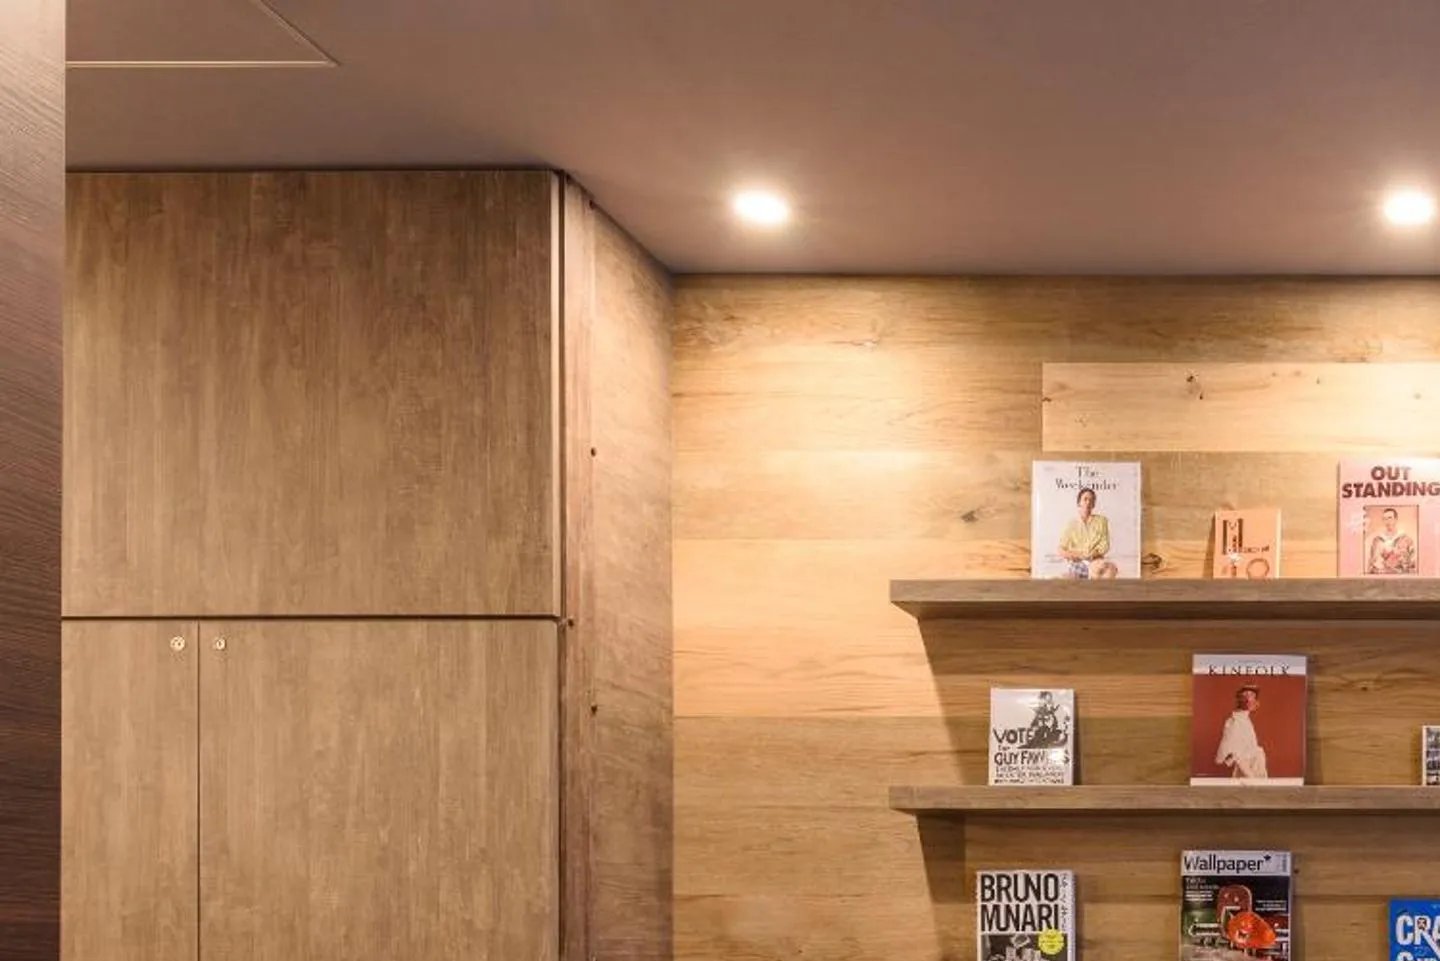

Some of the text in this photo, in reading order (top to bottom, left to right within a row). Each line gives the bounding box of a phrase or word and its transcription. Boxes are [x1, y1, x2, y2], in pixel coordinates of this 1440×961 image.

[1370, 465, 1412, 481] OUT
[992, 726, 1034, 745] VOTE
[980, 872, 1060, 903] BRUNO
